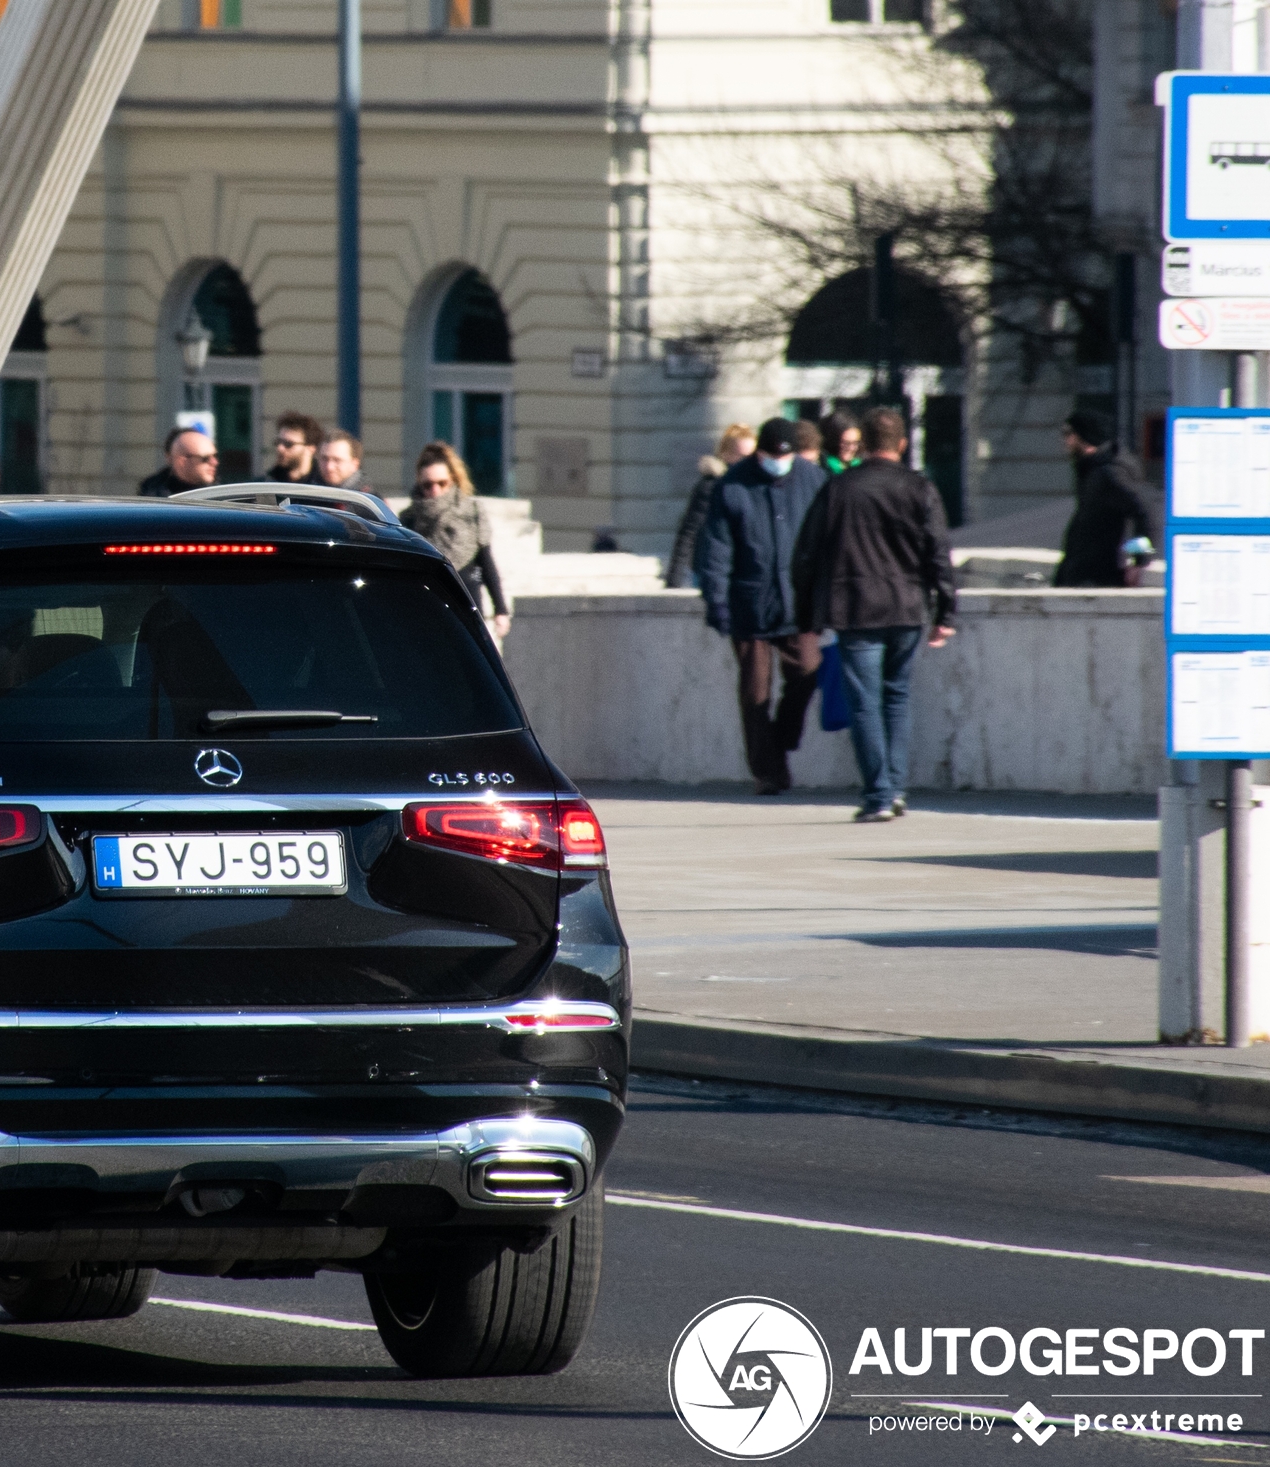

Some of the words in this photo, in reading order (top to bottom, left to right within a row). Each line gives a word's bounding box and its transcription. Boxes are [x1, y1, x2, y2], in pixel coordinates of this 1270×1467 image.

[428, 773, 469, 786] GLS
[474, 773, 515, 785] 600
[132, 841, 330, 881] SYJ-959
[103, 866, 115, 881] H
